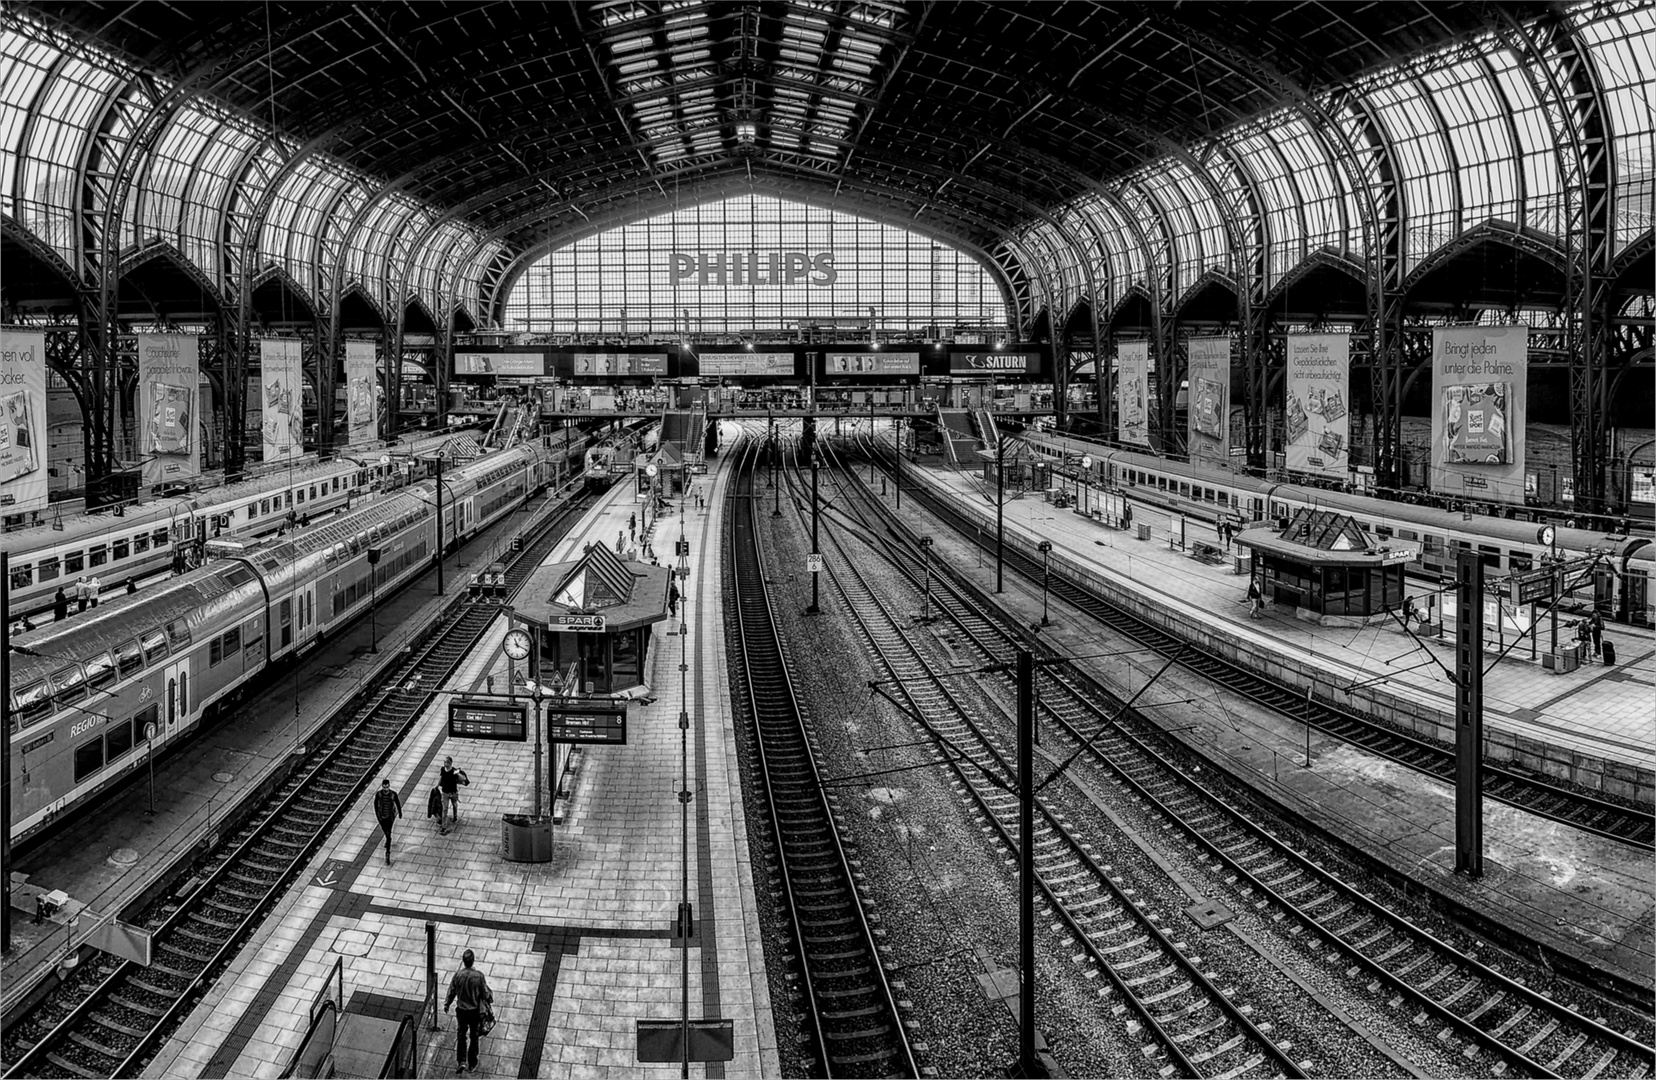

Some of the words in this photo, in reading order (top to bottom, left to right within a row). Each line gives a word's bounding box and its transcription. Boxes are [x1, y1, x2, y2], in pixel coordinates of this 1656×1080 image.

[669, 252, 838, 287] PHILIPS
[19, 345, 34, 361] voll
[1445, 341, 1469, 358] Bringt
[1470, 339, 1496, 358] jeden
[986, 355, 1026, 369] SATURN
[1445, 363, 1466, 374] unter
[1467, 359, 1482, 374] die
[1484, 359, 1514, 374] Palme.
[114, 505, 120, 515] D
[1451, 501, 1456, 511] E
[219, 516, 227, 526] D
[1301, 525, 1307, 536] E
[1389, 551, 1410, 559] SPAR
[453, 708, 458, 717] 7
[616, 715, 622, 724] 8
[70, 715, 96, 738] REGIO
